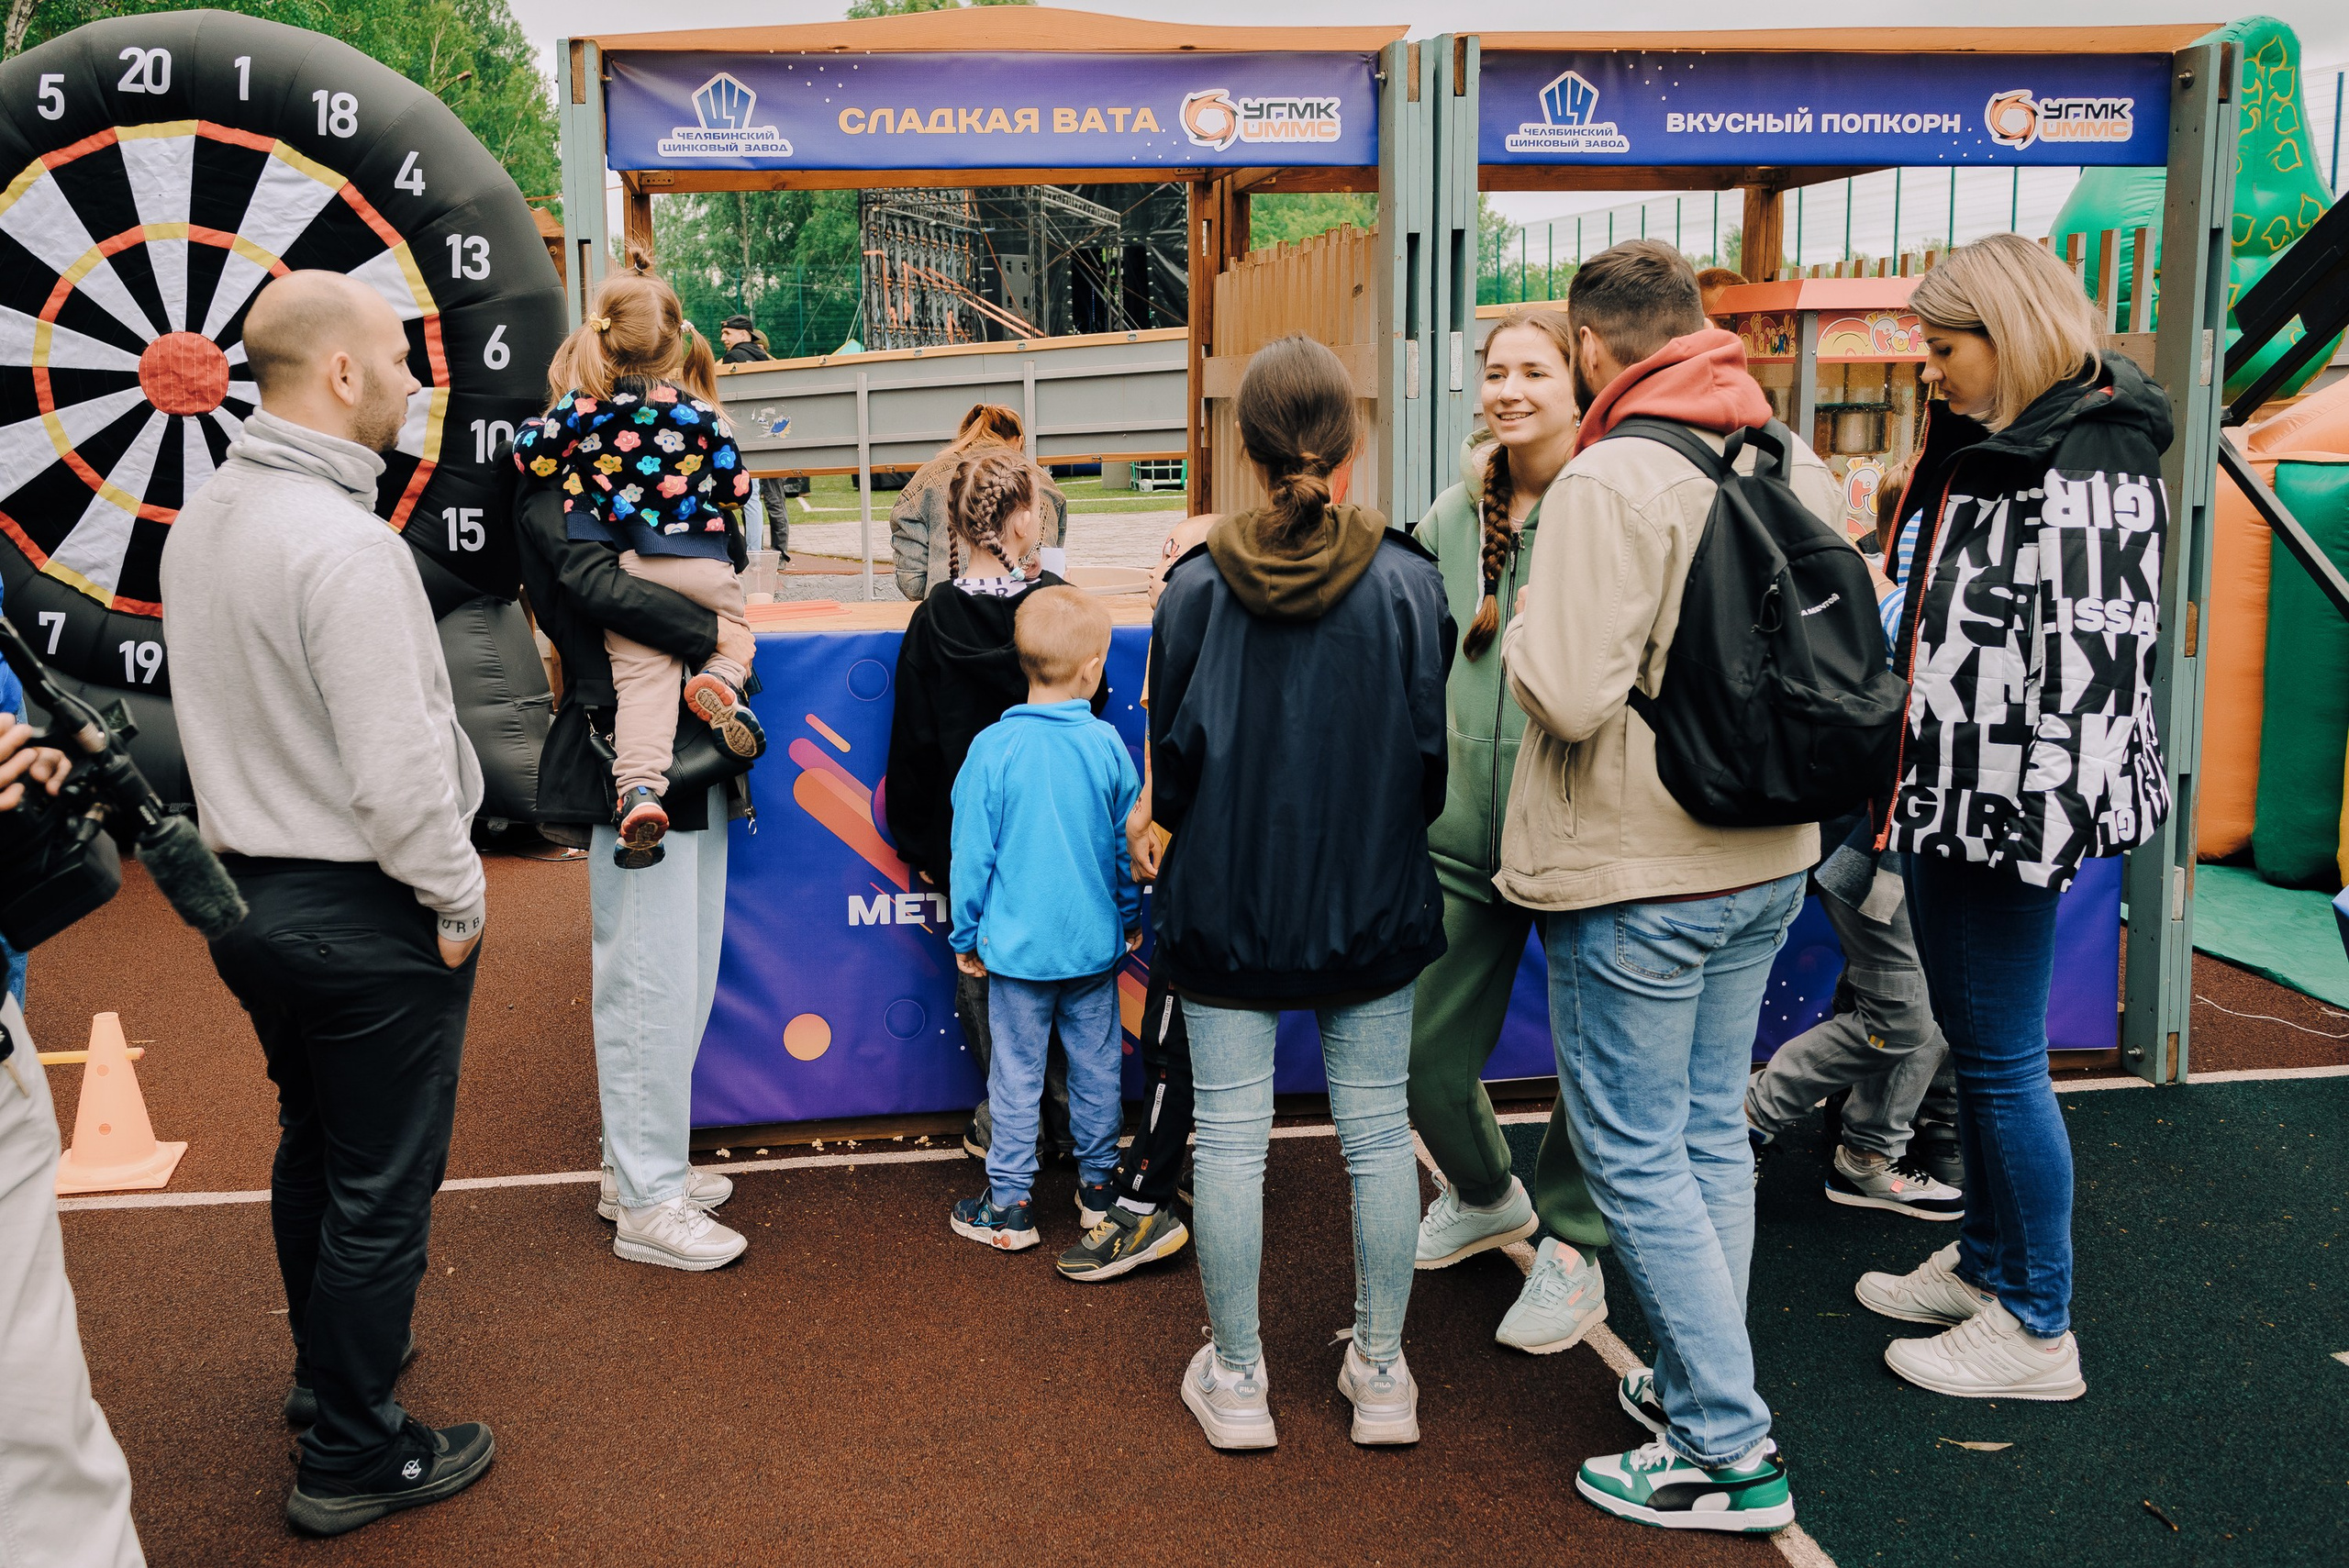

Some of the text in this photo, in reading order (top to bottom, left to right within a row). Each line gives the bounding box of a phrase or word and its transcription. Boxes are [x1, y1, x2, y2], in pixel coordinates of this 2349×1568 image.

[118, 47, 172, 94] 20
[235, 56, 250, 101] 1
[38, 74, 64, 119] 5
[1243, 103, 1334, 119] УГМК
[2043, 104, 2129, 119] УГМК
[313, 90, 359, 139] 18
[839, 107, 1160, 134] СЛАДКАЯ ВАТА
[1242, 121, 1337, 138] UMMC
[1524, 127, 1613, 136] ЧЕЛЯБИНСКИЙ
[1666, 107, 1961, 133] ВКУСНЫЙ ПОПКОРН
[2043, 122, 2129, 138] UMMC
[662, 141, 788, 152] ЦИНКОВЫЙ ЗАВОД
[677, 130, 774, 140] ЧЕЛЯБИНСКИЙ
[1509, 139, 1625, 148] ЦИНКОВЫЙ ЗАВОД
[395, 151, 425, 195] 4
[447, 234, 490, 280] 13
[484, 325, 510, 370] 6
[471, 419, 514, 463] 10
[442, 507, 485, 551] 15
[39, 612, 65, 654] 7
[119, 640, 162, 684] 19
[441, 917, 480, 933] URB
